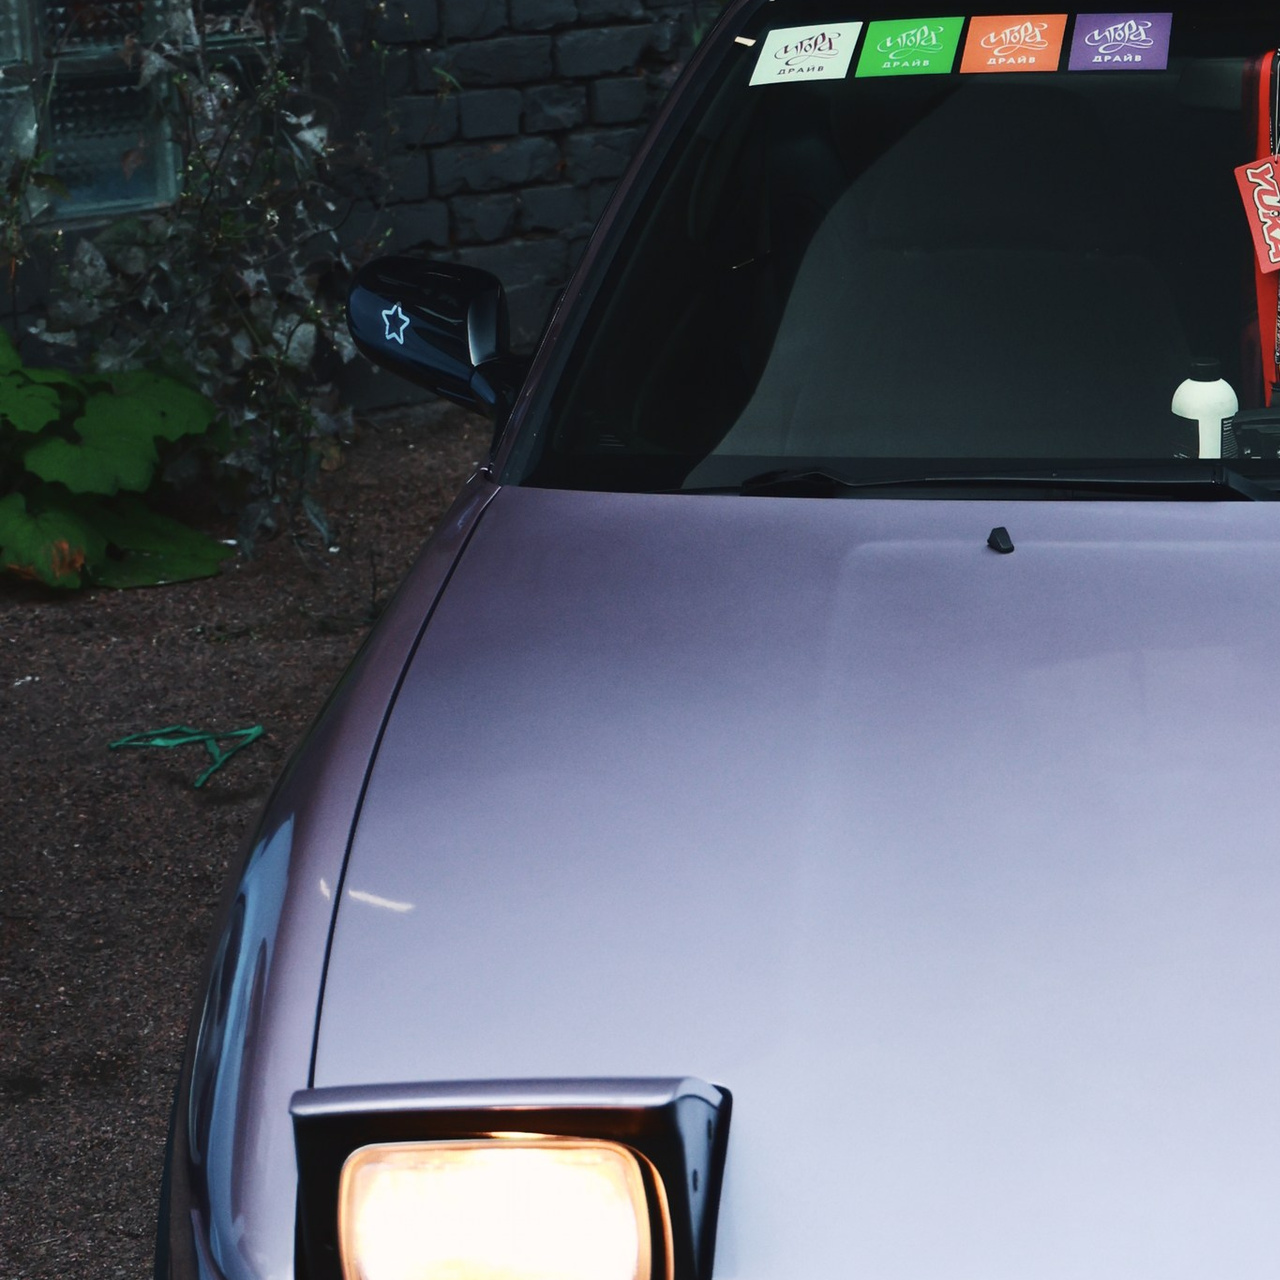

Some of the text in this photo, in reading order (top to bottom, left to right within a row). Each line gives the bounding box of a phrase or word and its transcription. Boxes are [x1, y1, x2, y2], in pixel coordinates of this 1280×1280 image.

[987, 55, 1036, 65] ДРАЙВ
[1092, 53, 1142, 63] ДРАЙВ
[882, 59, 930, 69] ДРАЙВ
[777, 65, 825, 76] ДРАЙВ
